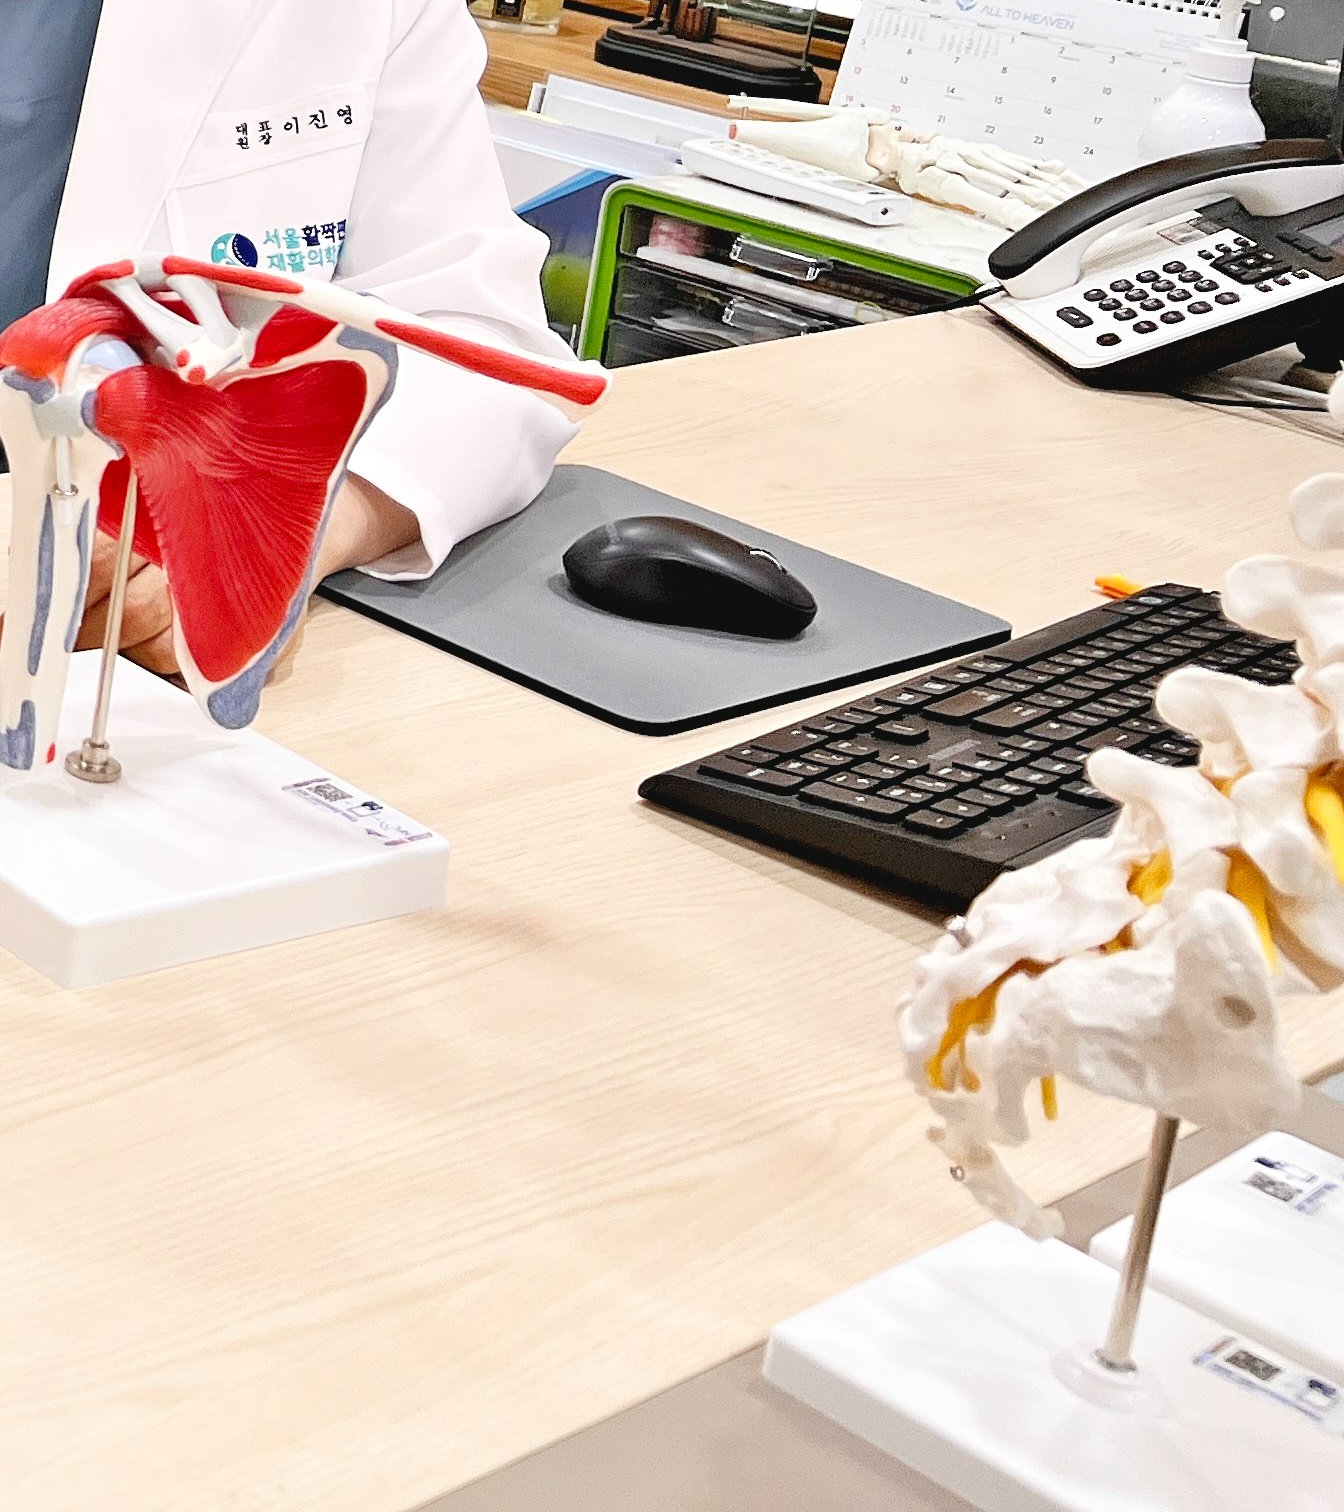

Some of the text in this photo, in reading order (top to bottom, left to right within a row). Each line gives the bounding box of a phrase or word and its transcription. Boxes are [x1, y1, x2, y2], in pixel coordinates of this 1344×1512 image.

[980, 5, 1076, 31] ALL TO HEAVEN
[1058, 46, 1065, 54] 2
[899, 76, 909, 85] 13
[994, 96, 1003, 105] 15
[1043, 106, 1052, 115] 16
[1093, 116, 1103, 125] 17
[283, 104, 353, 135] 이진영
[890, 104, 901, 114] 20
[937, 115, 946, 123] 21
[984, 125, 996, 134] 22
[1033, 135, 1044, 145] 23
[1083, 146, 1094, 156] 24
